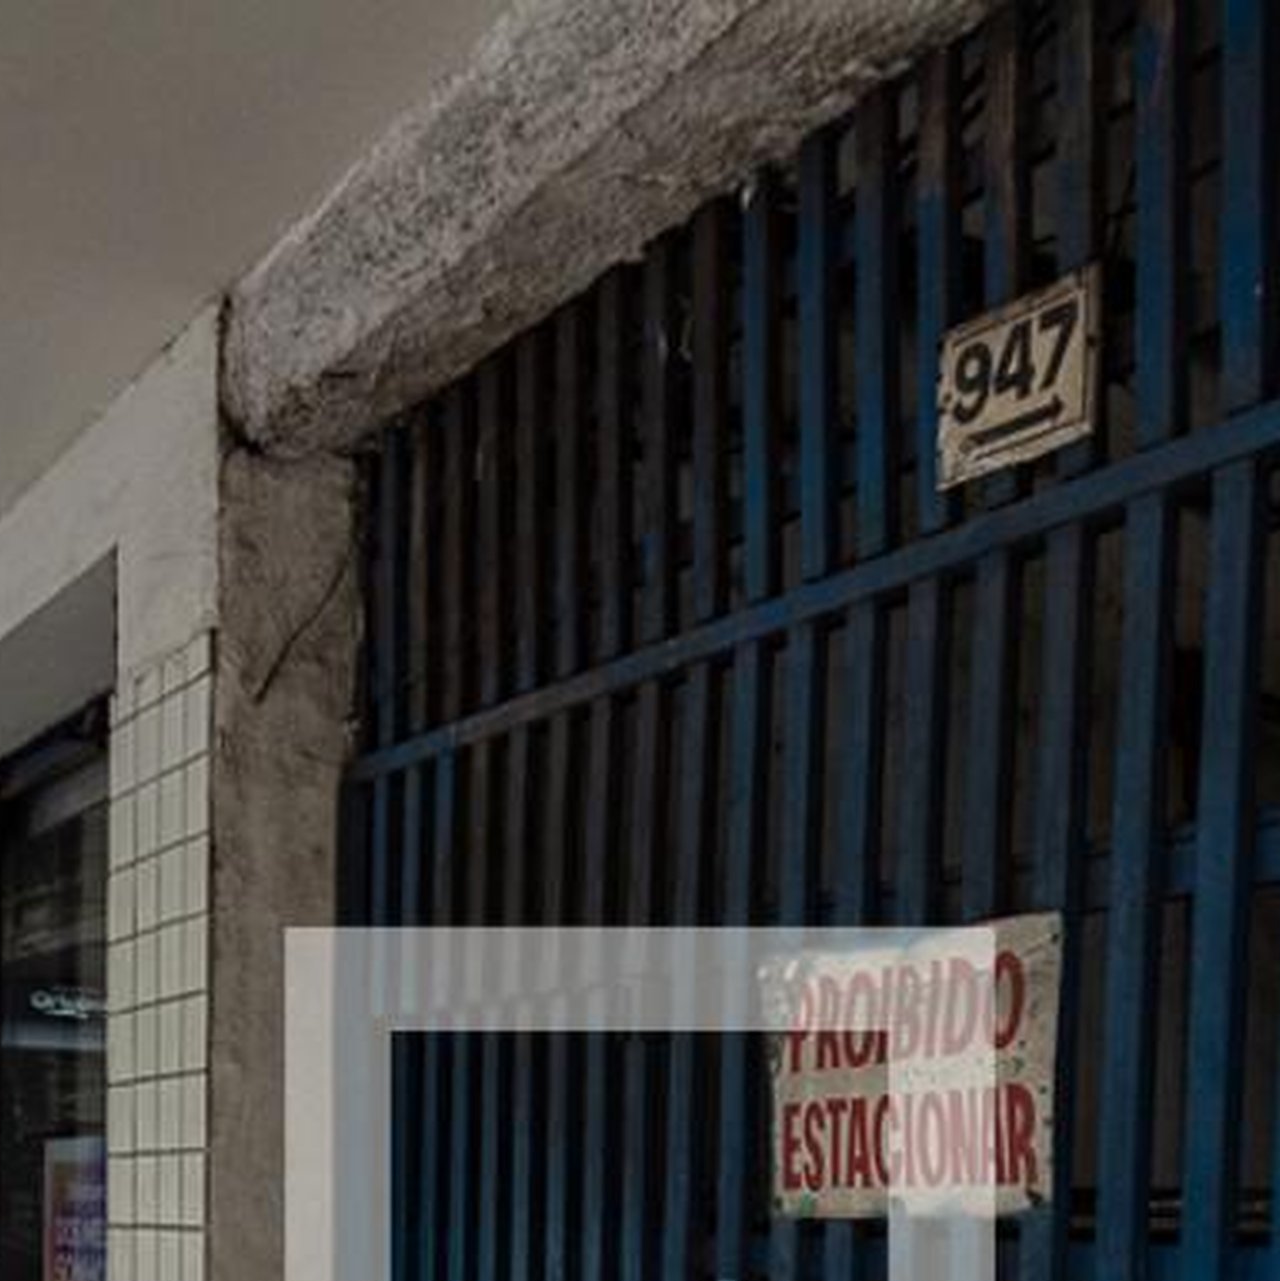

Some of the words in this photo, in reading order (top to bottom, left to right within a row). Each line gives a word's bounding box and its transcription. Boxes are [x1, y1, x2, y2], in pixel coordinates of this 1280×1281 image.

[953, 301, 1078, 423] 947
[785, 951, 1024, 1073] PROIBIDO
[781, 1083, 1038, 1191] ESTACIONAR
